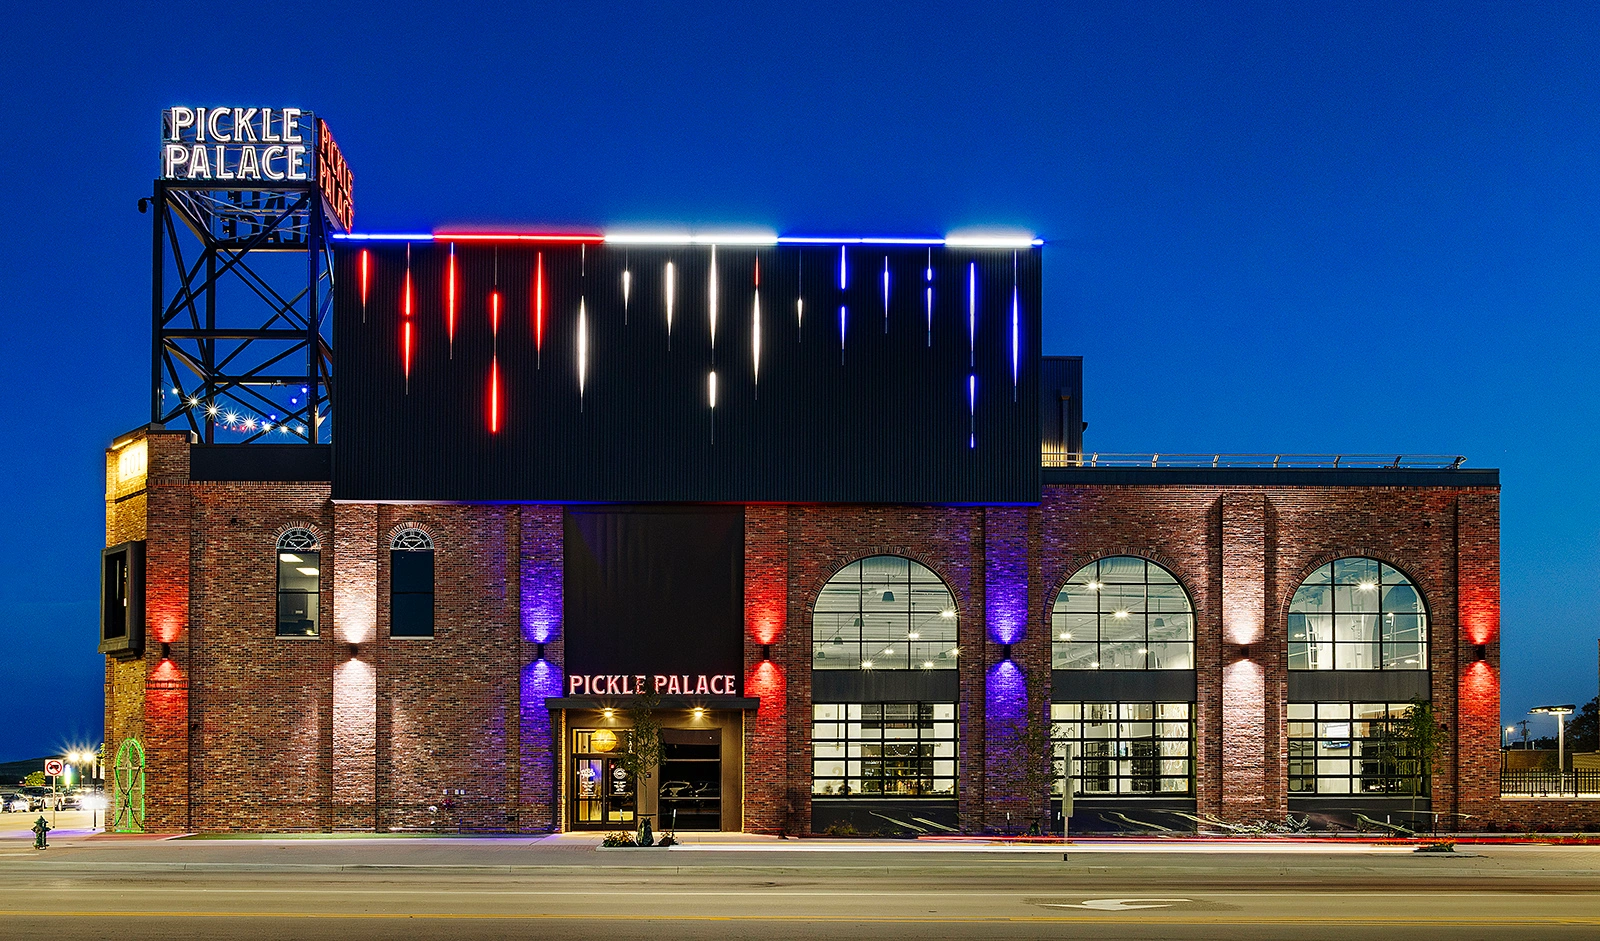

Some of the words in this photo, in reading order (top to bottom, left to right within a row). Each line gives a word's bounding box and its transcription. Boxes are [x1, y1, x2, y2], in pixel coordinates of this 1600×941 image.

[171, 107, 302, 142] PICKLE
[165, 144, 306, 180] PALACE
[321, 119, 354, 205] PICKLE
[319, 153, 354, 235] PALACE
[124, 452, 141, 476] 101
[569, 675, 647, 695] PICKLE
[653, 675, 737, 695] PALACE
